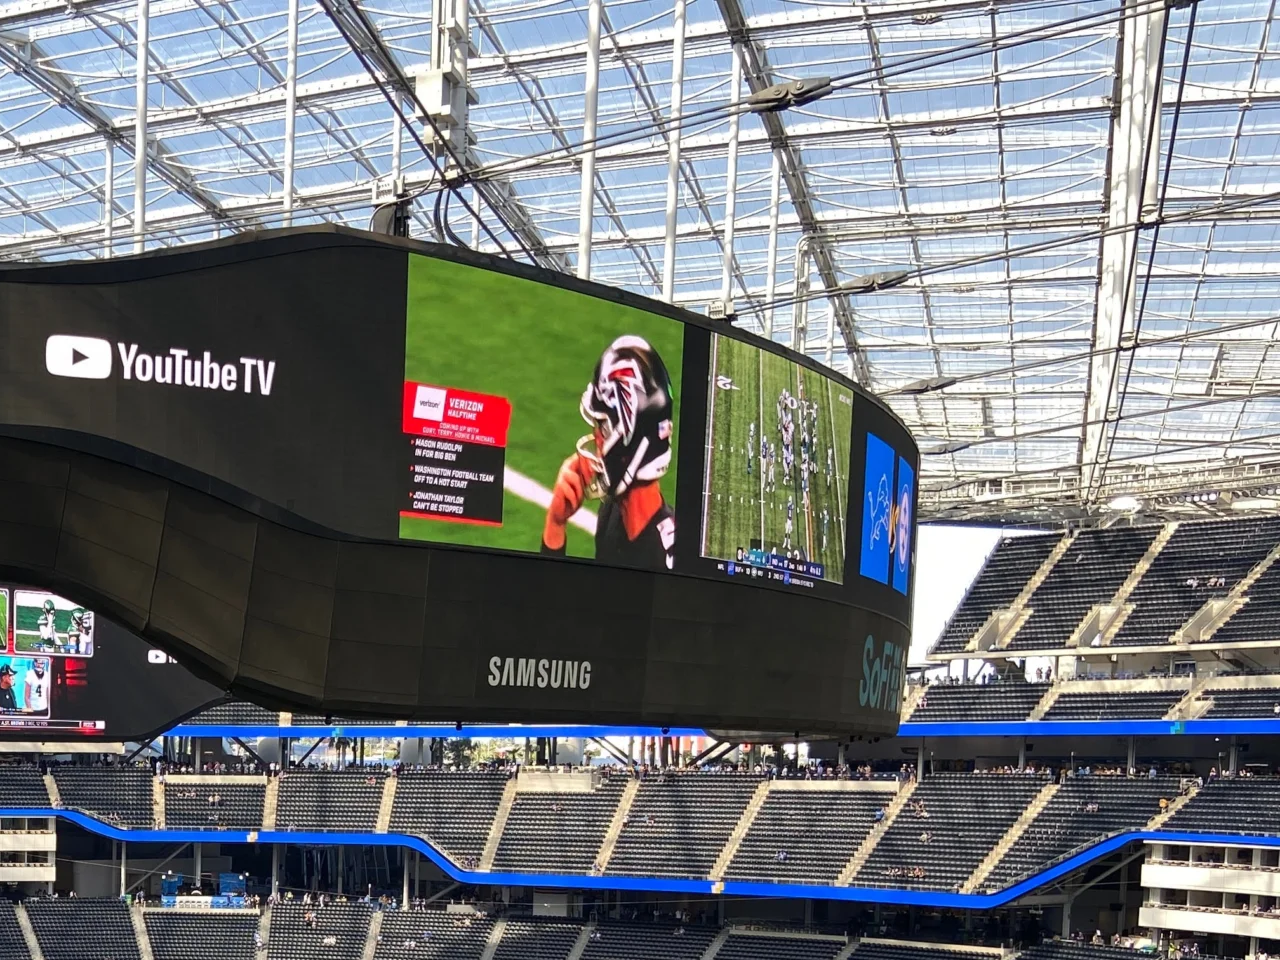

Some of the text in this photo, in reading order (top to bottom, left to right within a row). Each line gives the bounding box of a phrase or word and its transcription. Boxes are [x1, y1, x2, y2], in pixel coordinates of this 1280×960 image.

[117, 342, 276, 396] YouTube TV
[449, 398, 483, 412] VERIZON
[448, 410, 476, 420] HALFTIME
[416, 438, 462, 452] MASON RUDOLPH
[415, 449, 456, 461] IN FOR BIG BEN
[414, 465, 494, 482] WASHINGTON FOOTBALL TEAM
[414, 475, 425, 484] OFF
[438, 478, 450, 487] HOT
[450, 480, 468, 489] START
[413, 491, 464, 504] JONATHAN TAYLOR
[413, 501, 464, 514] CAN'T BE STOPPED
[488, 656, 592, 690] SAMSUNG
[859, 634, 894, 710] SoFi
